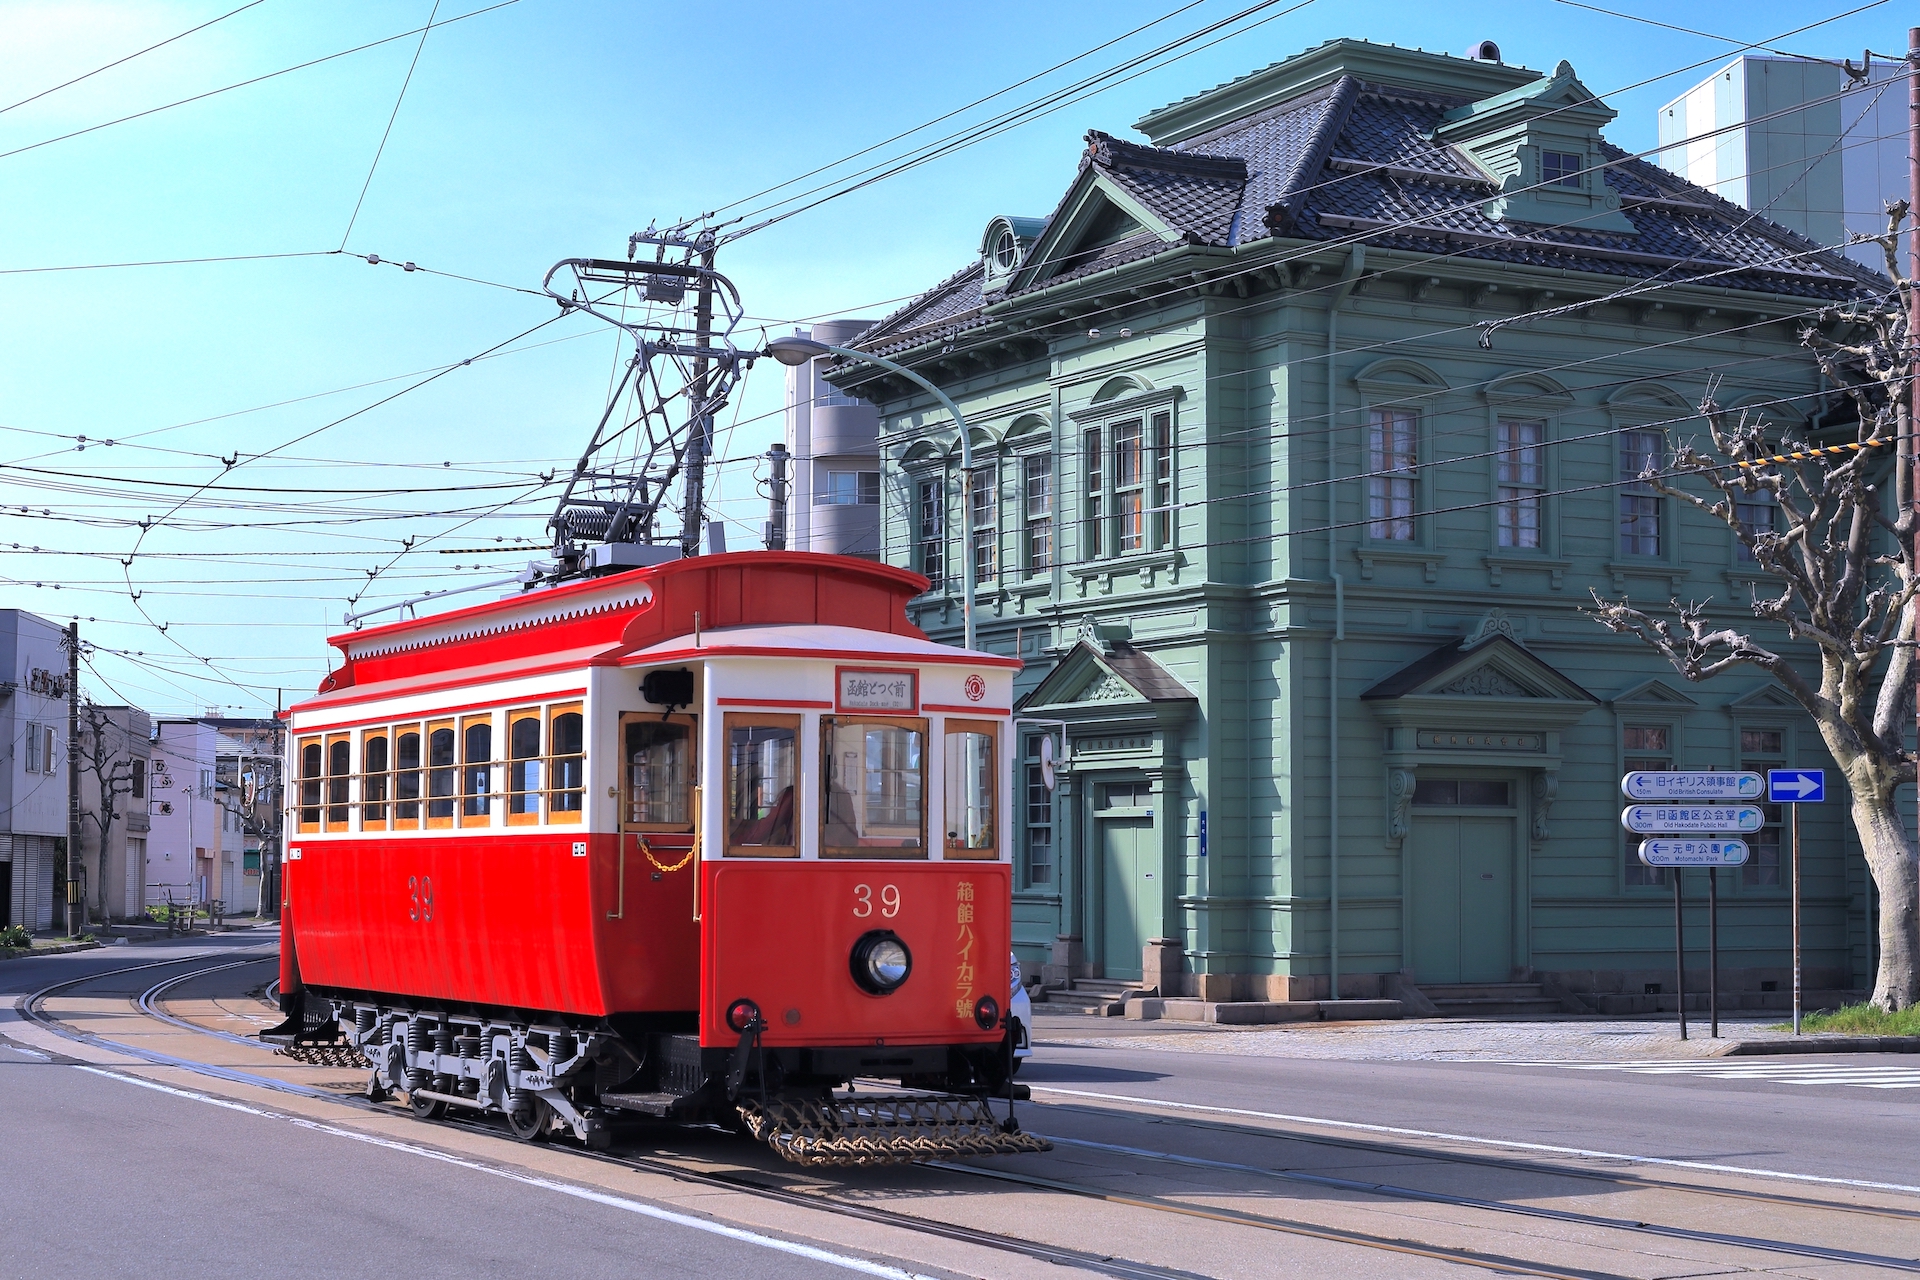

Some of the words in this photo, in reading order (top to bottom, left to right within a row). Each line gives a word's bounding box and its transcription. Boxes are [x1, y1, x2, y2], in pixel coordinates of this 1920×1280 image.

[847, 679, 906, 698] 函館どつく前
[1656, 776, 1736, 787] 旧イギリス領事館
[1656, 809, 1736, 821] 旧函館区公会堂
[1673, 843, 1721, 854] 元町公園
[409, 876, 434, 922] 39
[853, 883, 901, 918] 39
[956, 881, 974, 1019] 箱館ハイカラ號
